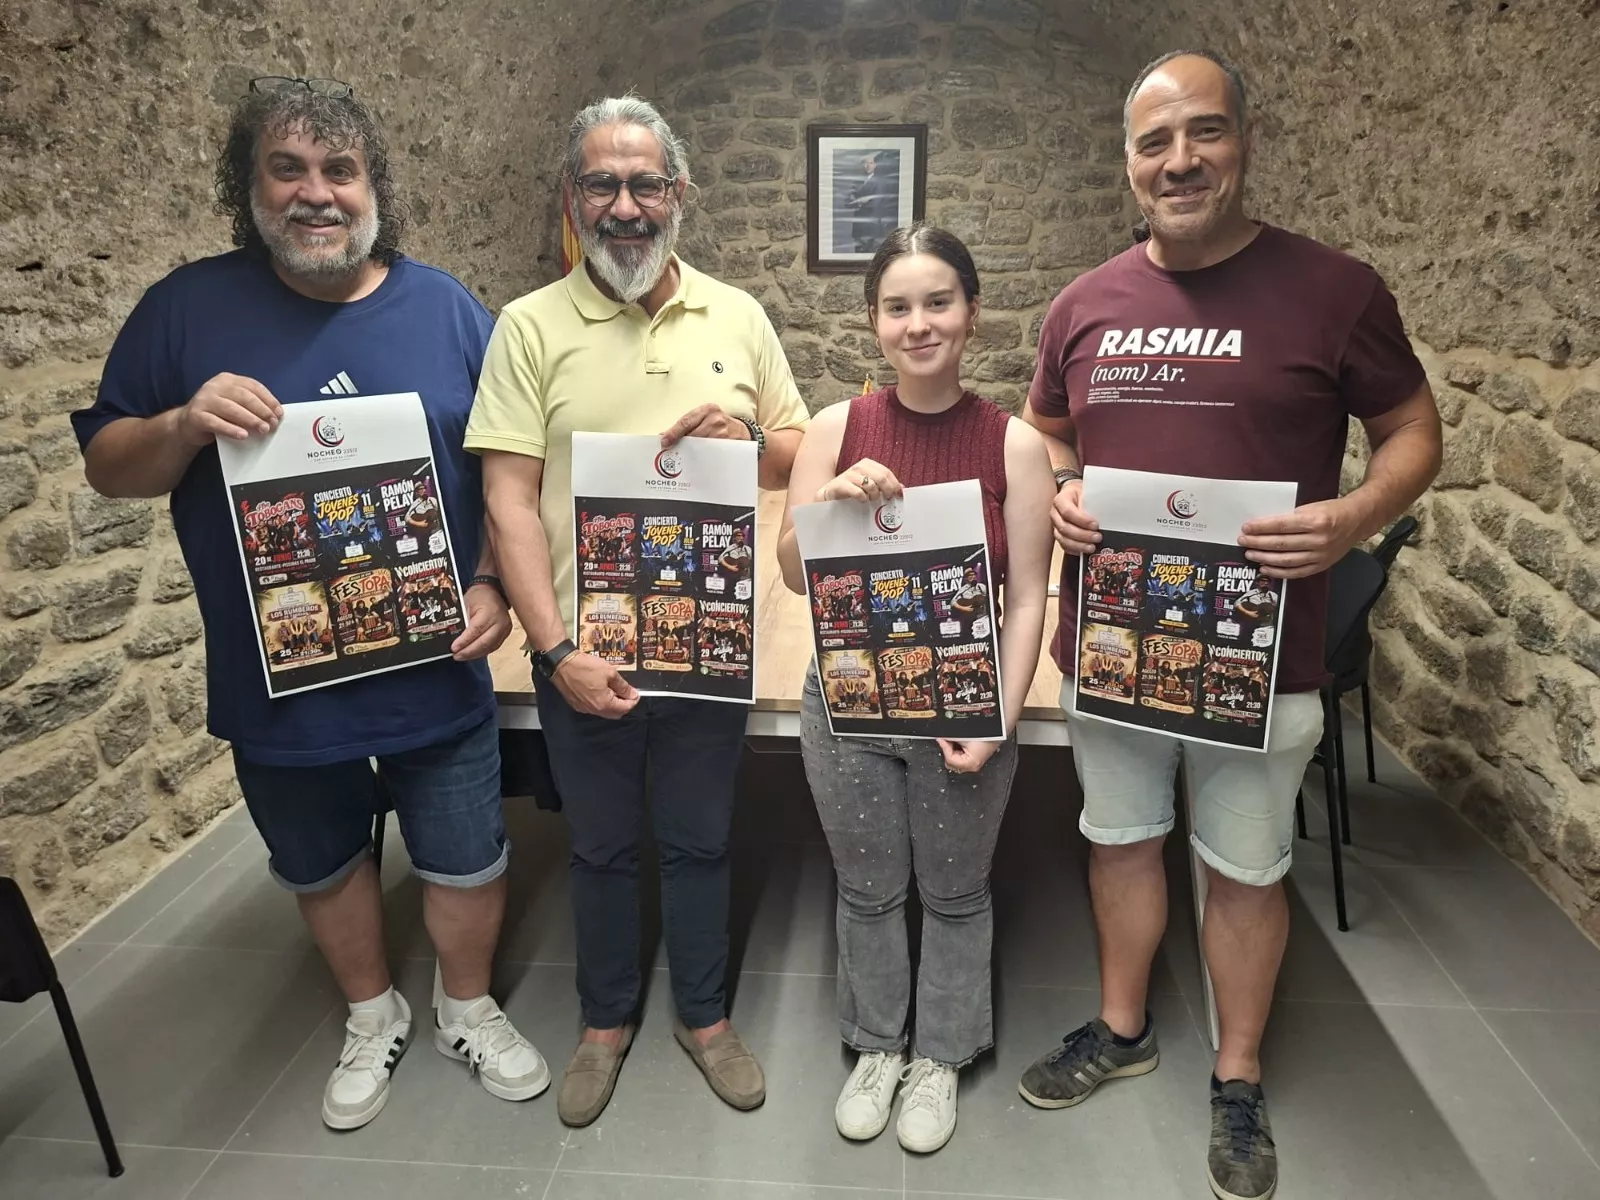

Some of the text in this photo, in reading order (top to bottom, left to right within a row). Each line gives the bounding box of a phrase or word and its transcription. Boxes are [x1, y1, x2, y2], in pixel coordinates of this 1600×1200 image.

[1096, 327, 1242, 357] RASMIA
[1090, 363, 1186, 384] (nom) Ar.
[307, 448, 342, 459] NOCHEO
[314, 486, 352, 503] CONCIERTO
[380, 479, 415, 499] RAMÓN
[317, 493, 359, 519] JÓVENES
[362, 492, 372, 506] 11
[383, 491, 414, 512] PELAY
[244, 498, 305, 527] TOBOGANS
[328, 506, 355, 526] POP
[582, 516, 635, 535] TOBOGANS
[644, 516, 678, 526] CONCIERTO
[1157, 518, 1191, 527] NOCHEO
[643, 524, 683, 540] JÓVENES
[685, 526, 693, 538] 11
[703, 522, 733, 536] RAMÓN
[652, 535, 677, 549] POP
[702, 536, 731, 548] PELAY
[868, 534, 899, 542] NOCHEO
[254, 556, 266, 566] 20
[403, 557, 445, 577] CONCIERTO
[584, 562, 594, 570] 20
[1089, 552, 1142, 567] TOBOGANS
[1153, 554, 1189, 565] CONCIERTO
[870, 569, 903, 581] CONCIERTO
[931, 565, 964, 582] RAMÓN
[1151, 564, 1195, 577] JÓVENES
[1197, 568, 1206, 580] 11
[1218, 566, 1256, 580] RAMÓN
[332, 575, 390, 600] FESTOPA
[815, 575, 863, 596] TOBOGANS
[871, 575, 909, 596] JÓVENES
[911, 576, 920, 588] 11
[931, 577, 963, 595] PELAY
[1159, 575, 1187, 587] POP
[1216, 579, 1254, 592] PELAY
[880, 587, 905, 603] POP
[270, 610, 284, 619] LOS
[284, 604, 319, 615] RUMBEROS
[643, 601, 693, 618] FESTOPA
[706, 600, 745, 614] CONCIERTO
[406, 615, 417, 626] 29
[280, 648, 292, 657] 25
[701, 649, 710, 657] 29
[943, 642, 985, 657] CONCIERTO
[1144, 639, 1199, 660] FESTOPA
[1215, 646, 1262, 661] CONCIERTO
[880, 652, 930, 669] FESTOPA
[943, 693, 953, 702] 29
[1205, 694, 1216, 702] 29
[1246, 701, 1260, 709] 21:30
